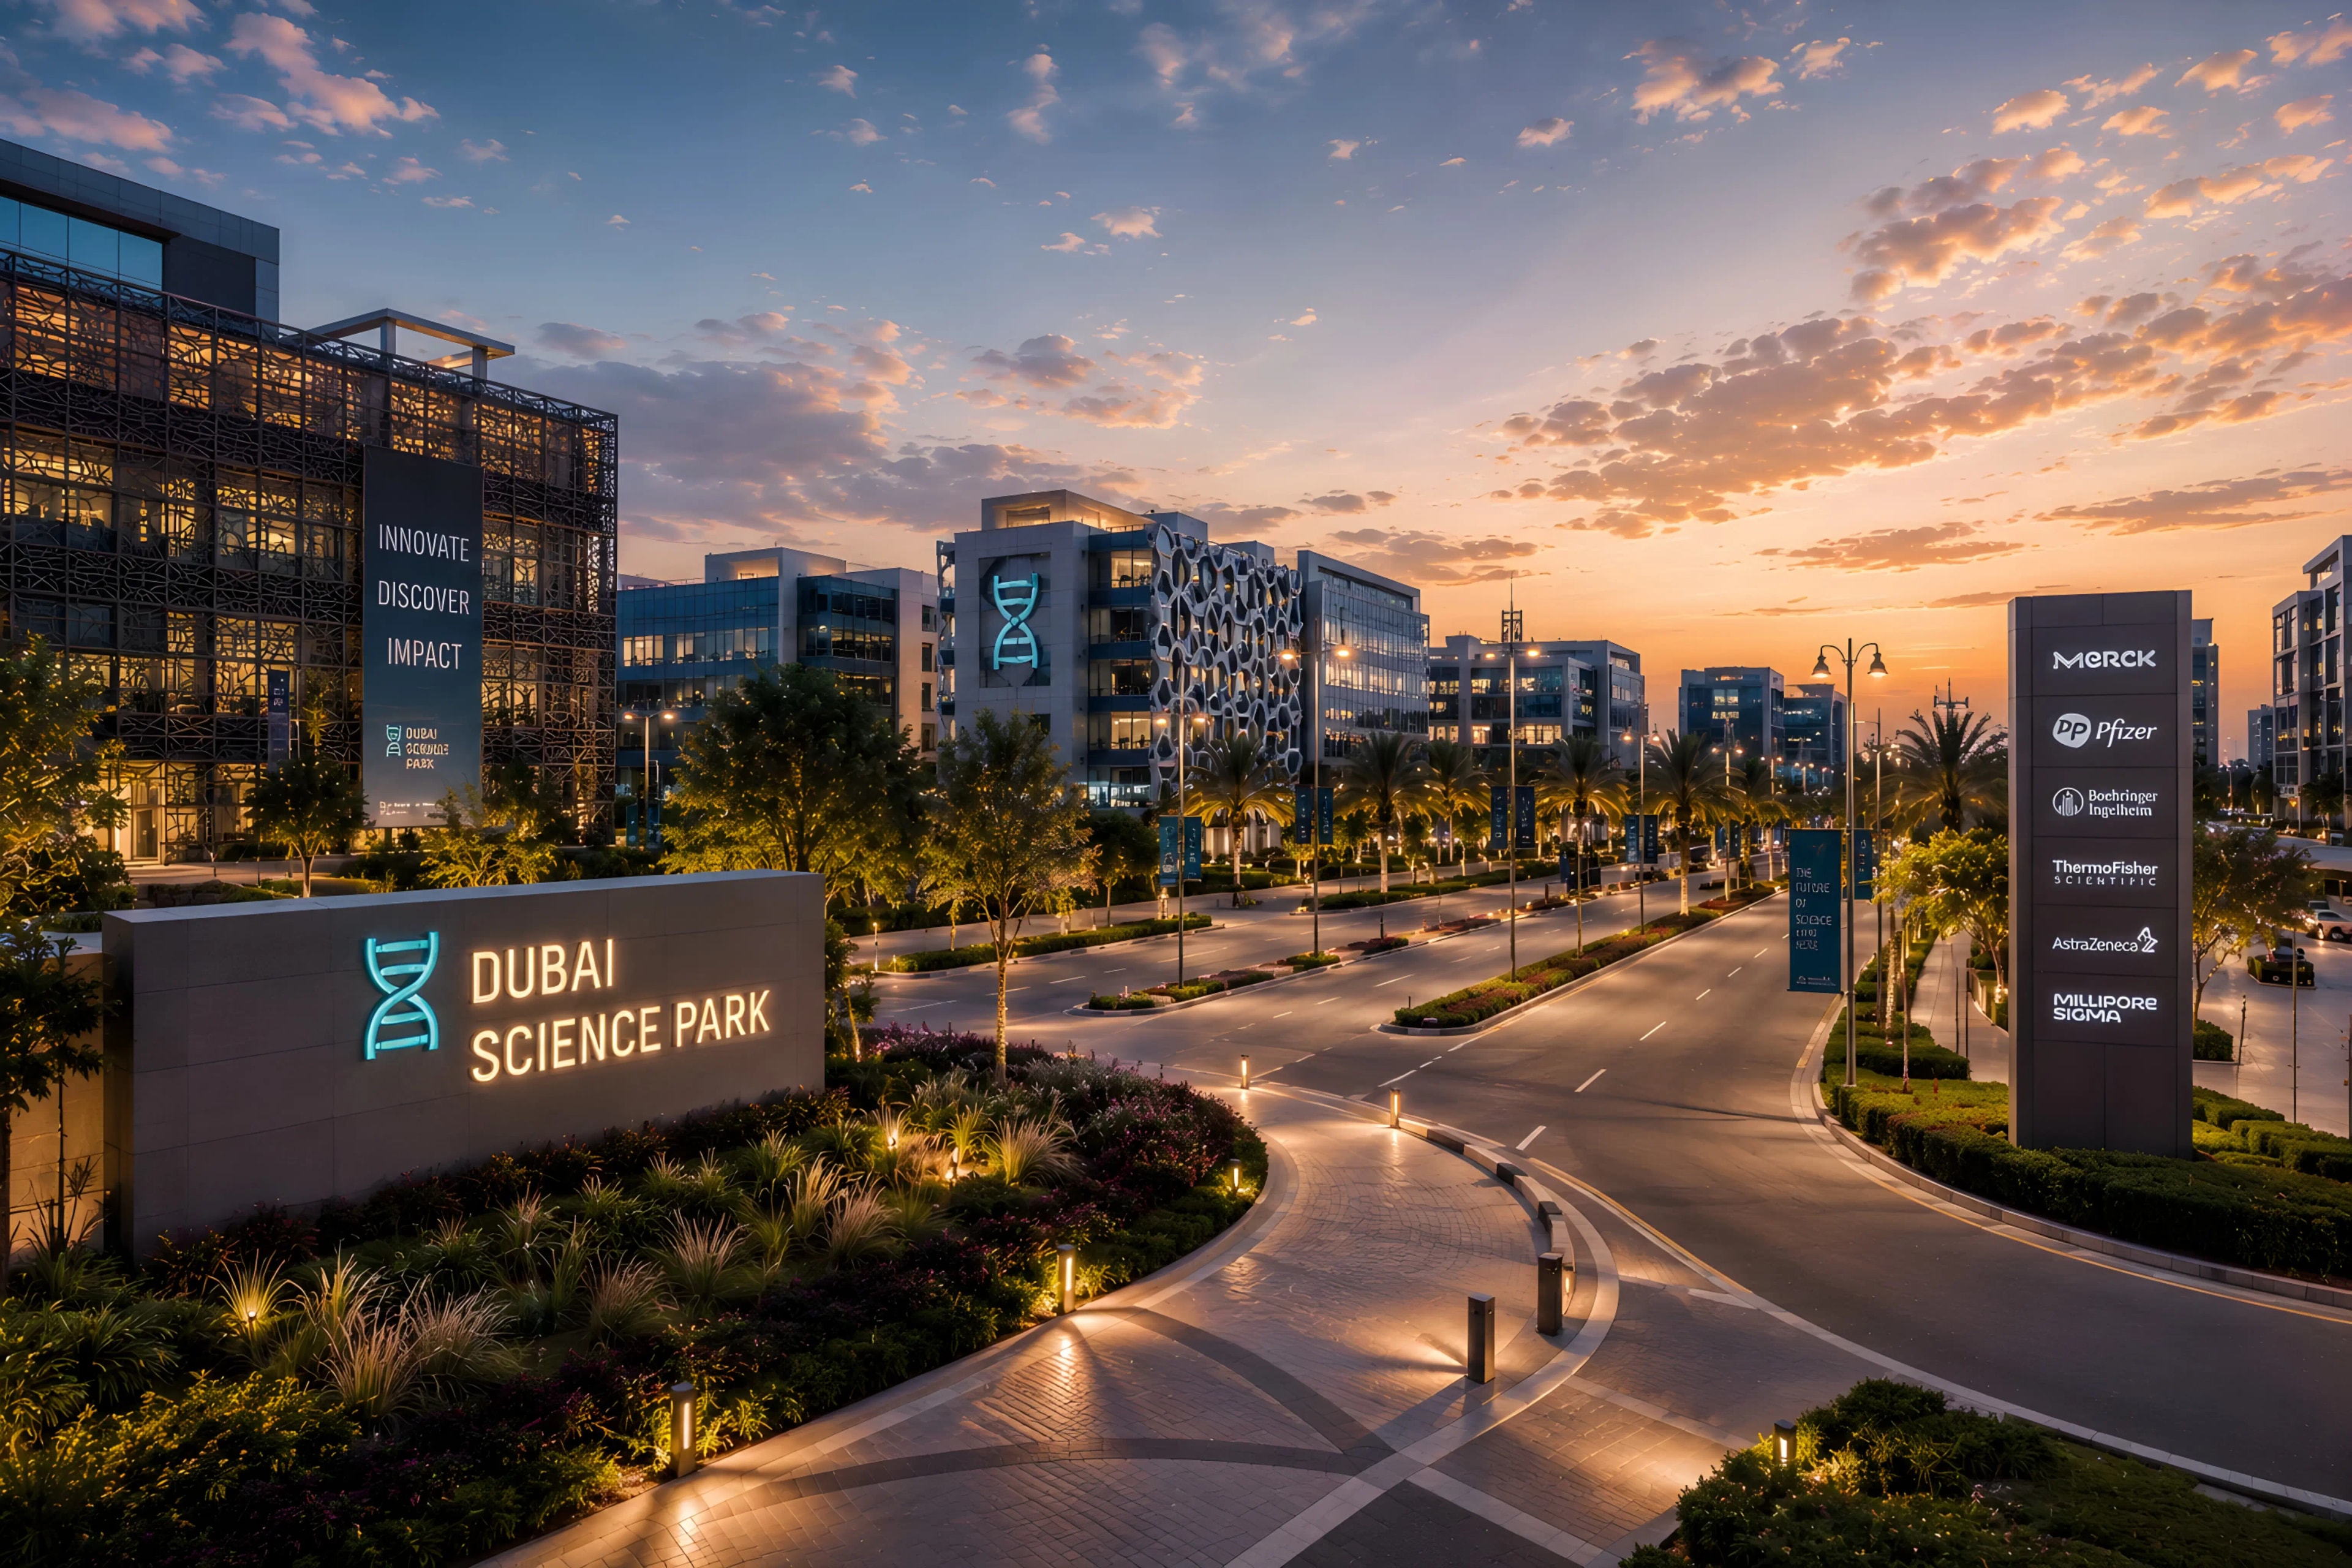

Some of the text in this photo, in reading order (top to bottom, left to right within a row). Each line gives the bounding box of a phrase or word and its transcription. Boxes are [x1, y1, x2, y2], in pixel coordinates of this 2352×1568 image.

[379, 524, 469, 562] INNOVATE
[379, 580, 469, 615] DISCOVER
[388, 638, 462, 669] IMPACT
[2095, 718, 2157, 748] Pfizer
[2052, 859, 2158, 875] ThermoFisher
[2052, 936, 2138, 952] AstraZeneca
[472, 938, 613, 1005] DUBAI
[2053, 1007, 2122, 1023] SIGMA
[471, 989, 771, 1082] SCIENCE PARK
